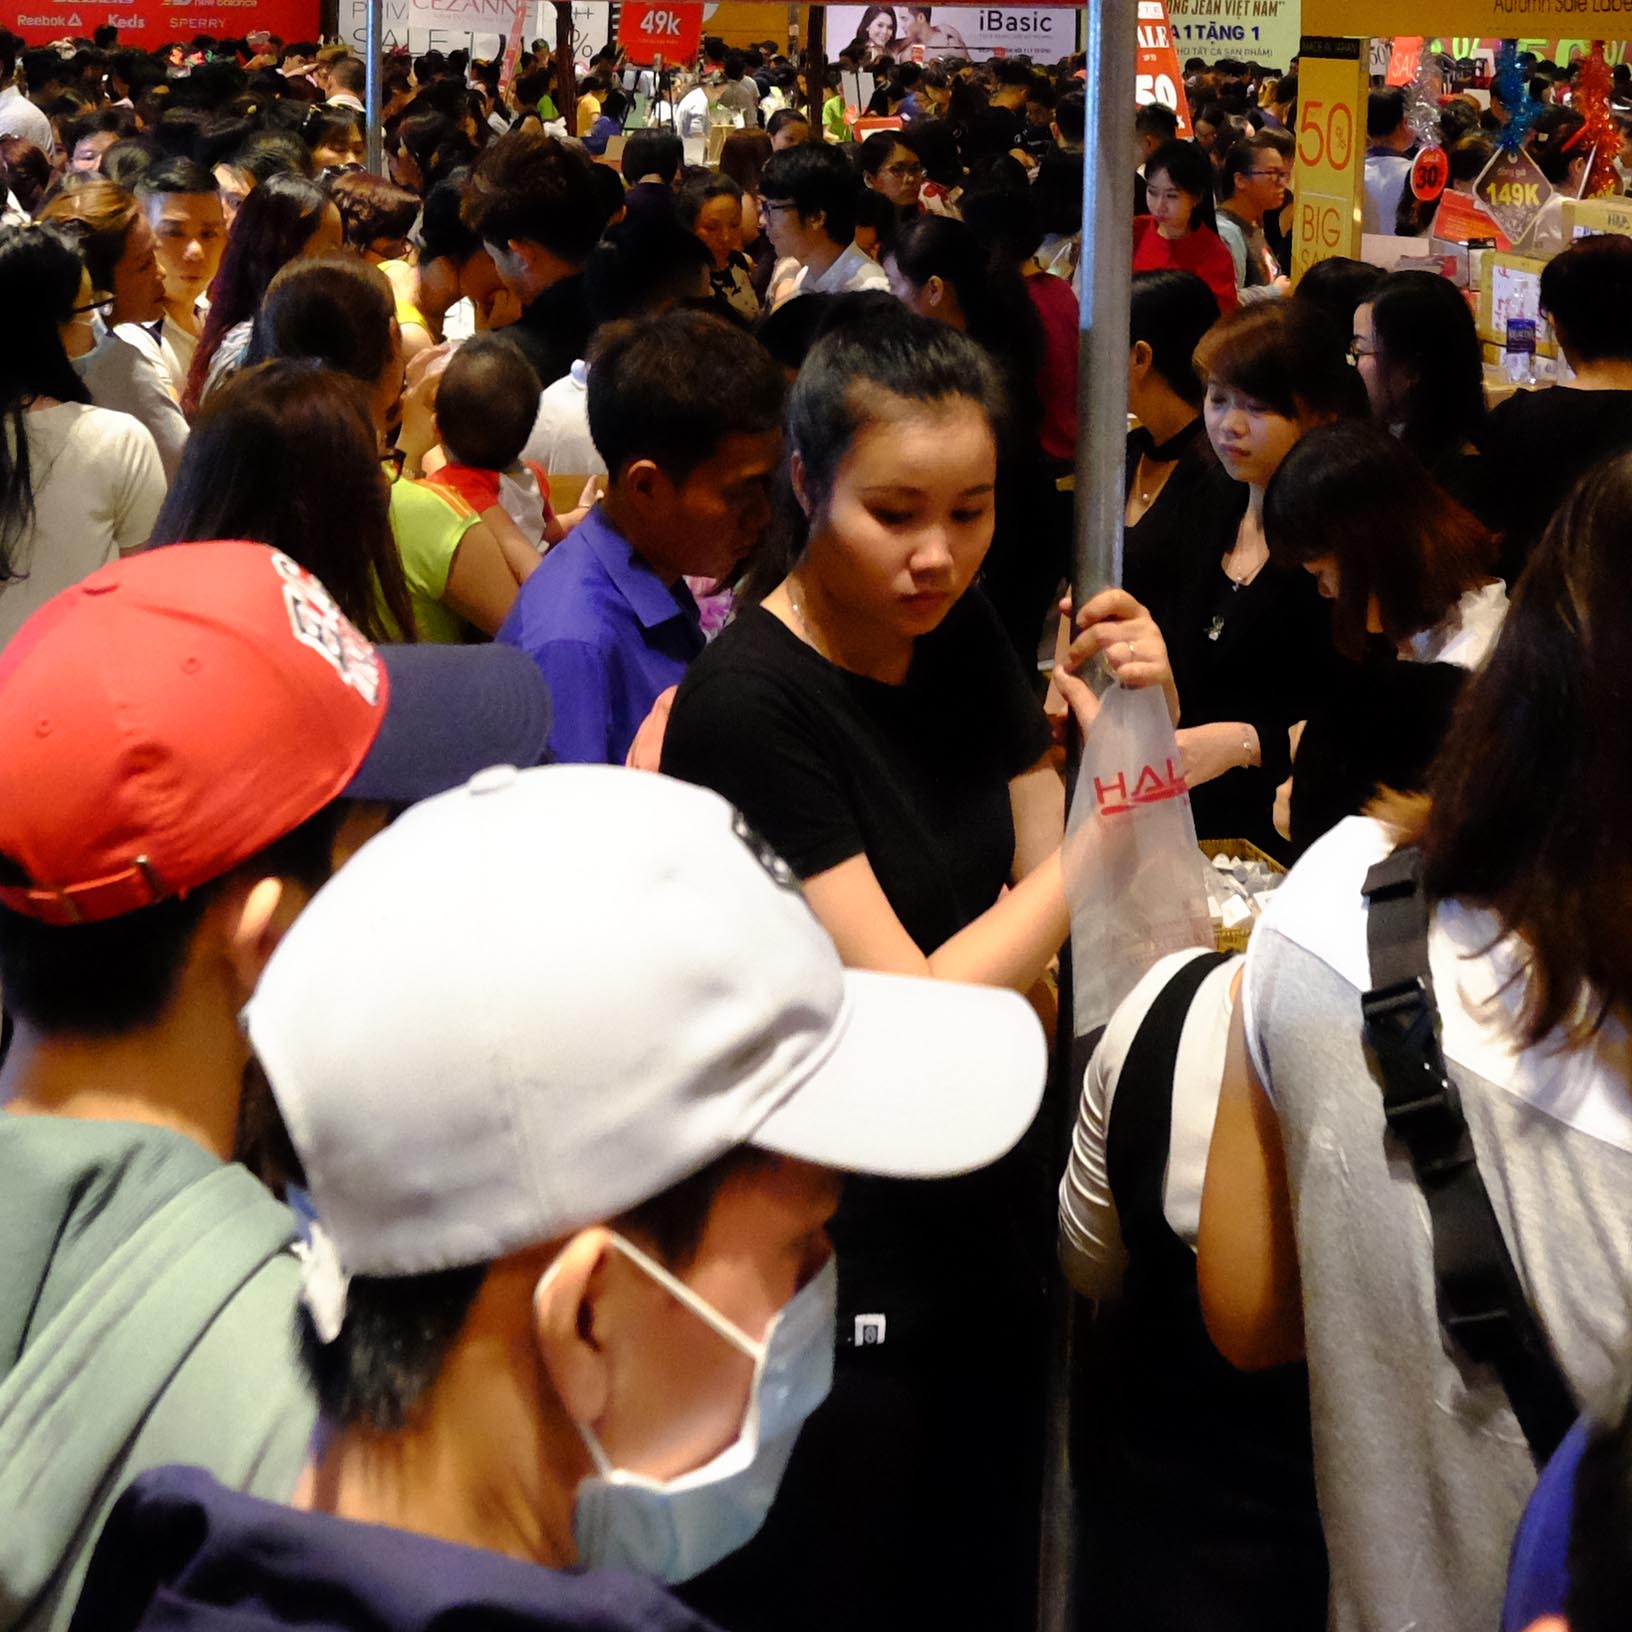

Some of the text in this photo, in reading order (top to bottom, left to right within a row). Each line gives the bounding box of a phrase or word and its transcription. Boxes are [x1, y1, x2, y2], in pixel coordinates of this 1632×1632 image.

[1191, 0, 1221, 16] JEAN
[18, 15, 66, 27] Reebok
[108, 14, 145, 30] Keds
[169, 17, 226, 29] SPERRY
[640, 10, 681, 35] 49k
[979, 10, 1052, 32] iBasic
[1252, 26, 1260, 41] 1
[1297, 100, 1354, 172] 50%
[1487, 182, 1541, 208] 149K
[1301, 204, 1341, 249] BIG
